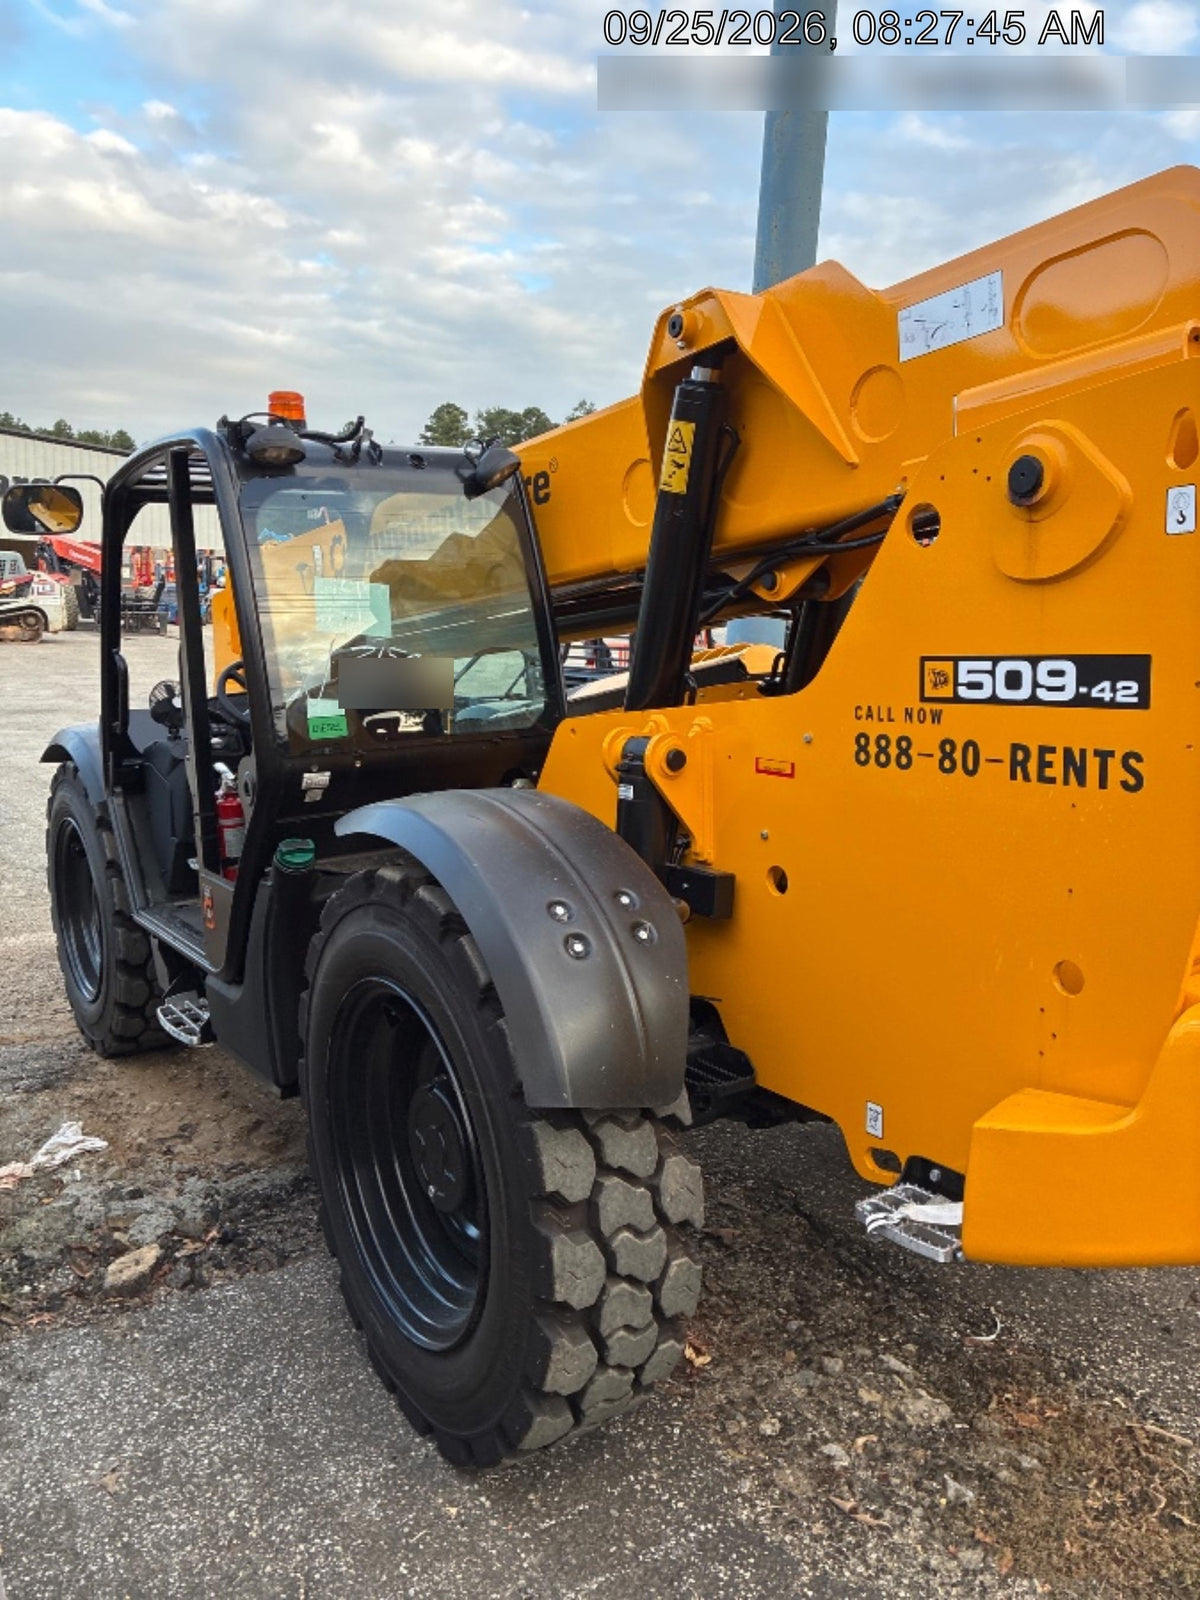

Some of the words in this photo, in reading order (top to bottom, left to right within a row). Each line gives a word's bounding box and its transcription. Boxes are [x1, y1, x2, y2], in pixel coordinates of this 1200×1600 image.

[957, 659, 1139, 703] 509-42
[854, 705, 895, 723] CALL
[904, 707, 943, 725] NOW
[854, 732, 1145, 793] 888-80-RENTS
